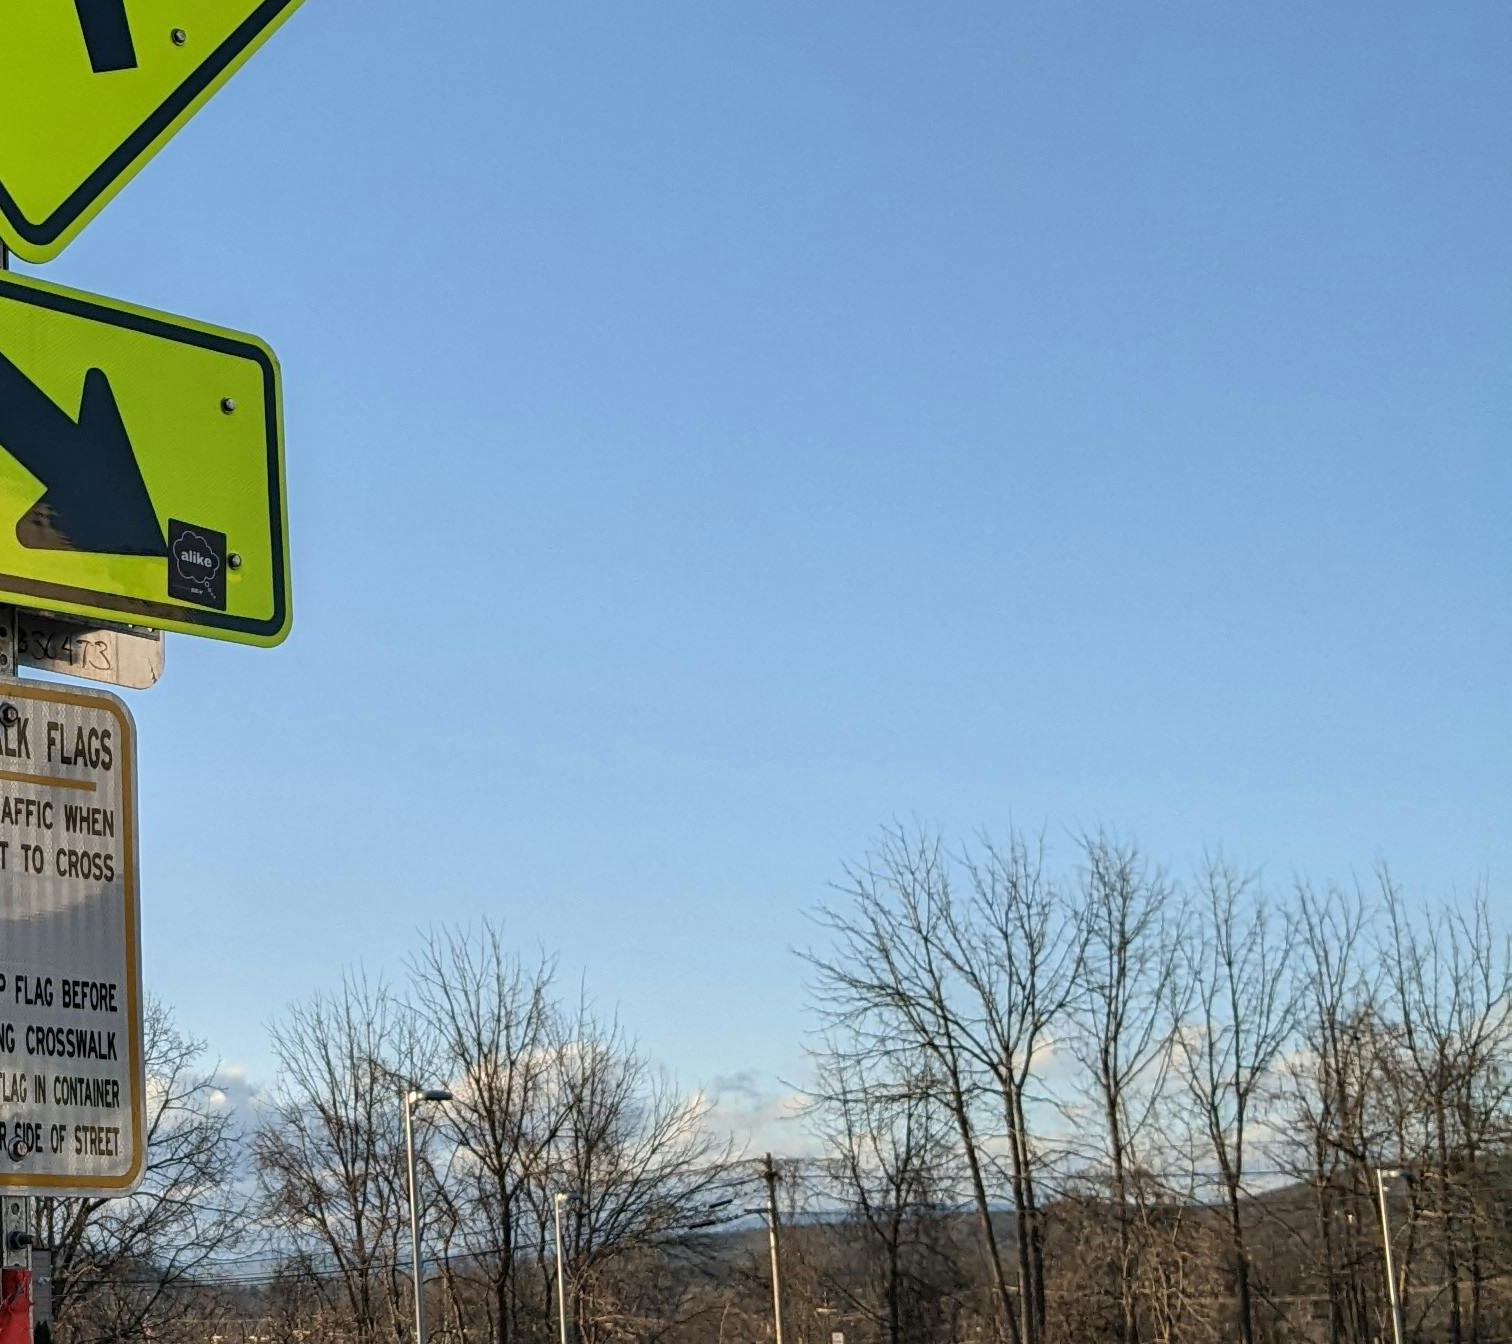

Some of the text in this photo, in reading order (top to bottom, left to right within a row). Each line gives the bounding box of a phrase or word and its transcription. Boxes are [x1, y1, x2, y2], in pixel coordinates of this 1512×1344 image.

[181, 550, 212, 568] alike
[47, 721, 113, 772] FLAGS
[64, 804, 114, 838] WHEN
[20, 844, 44, 874] TO
[56, 848, 115, 882] CROSS
[15, 975, 53, 1007] FLAG
[62, 979, 118, 1012] BEFORE
[26, 1024, 118, 1061] CROSSWALK
[35, 1075, 46, 1105] IN
[54, 1076, 120, 1108] CONTAINER
[50, 1124, 66, 1154] OF
[74, 1126, 120, 1156] STREET
